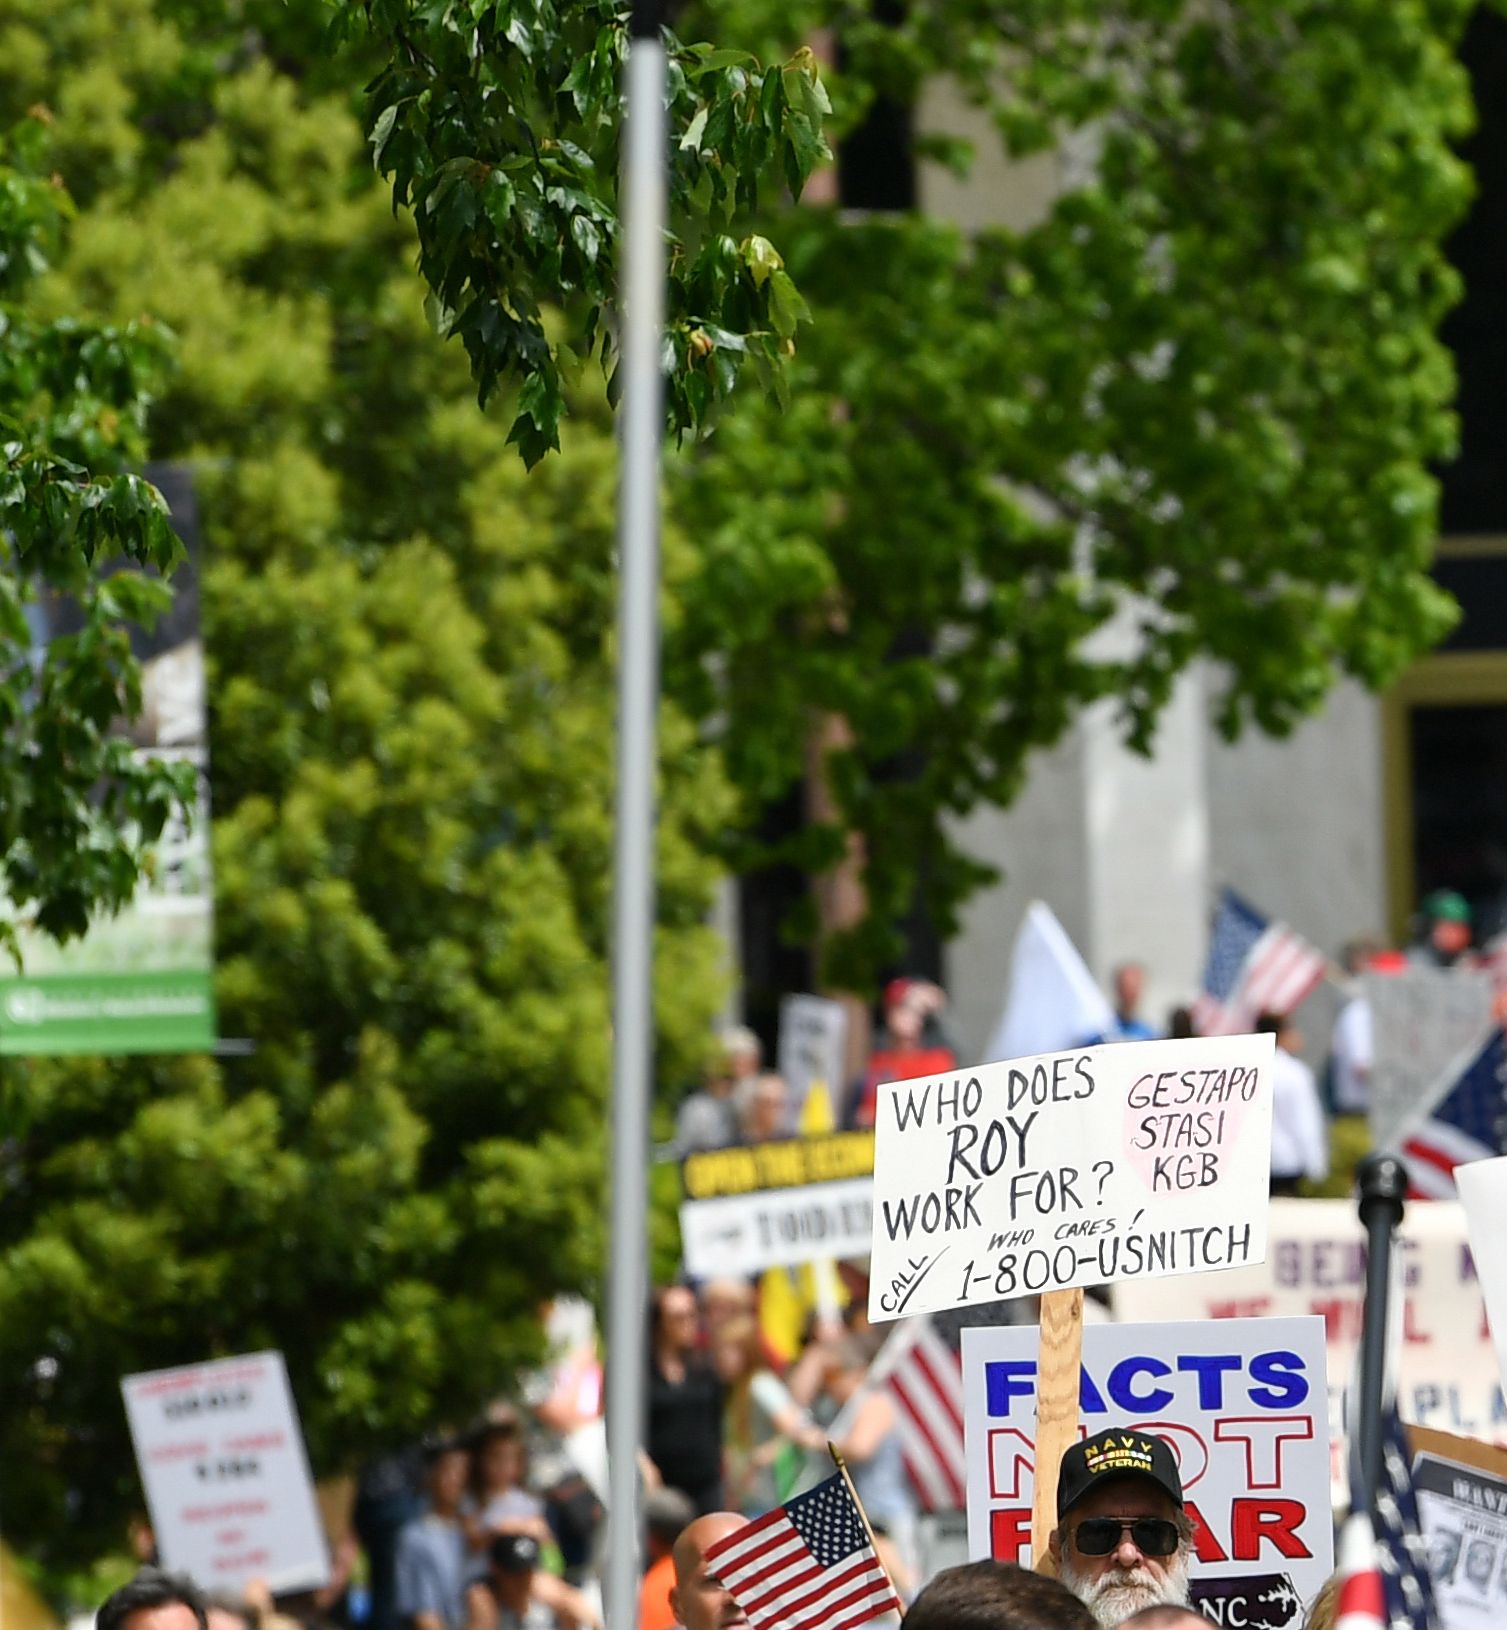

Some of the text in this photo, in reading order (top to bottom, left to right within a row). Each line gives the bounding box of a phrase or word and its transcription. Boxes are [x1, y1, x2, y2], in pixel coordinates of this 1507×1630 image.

[892, 1056, 1095, 1132] WHO DOES
[1127, 1067, 1258, 1109] GESTAPO
[945, 1111, 1039, 1185] ROY
[1131, 1111, 1224, 1150] STASI
[1152, 1152, 1219, 1192] KGB
[882, 1182, 984, 1241] WORK
[986, 1230, 1035, 1252] WHO
[880, 1255, 929, 1312] CALL
[956, 1223, 1251, 1301] 1-800-USNITCH
[1083, 1435, 1152, 1460] NAVY
[1088, 1457, 1153, 1474] VETERAN
[1199, 1595, 1248, 1628] NC
